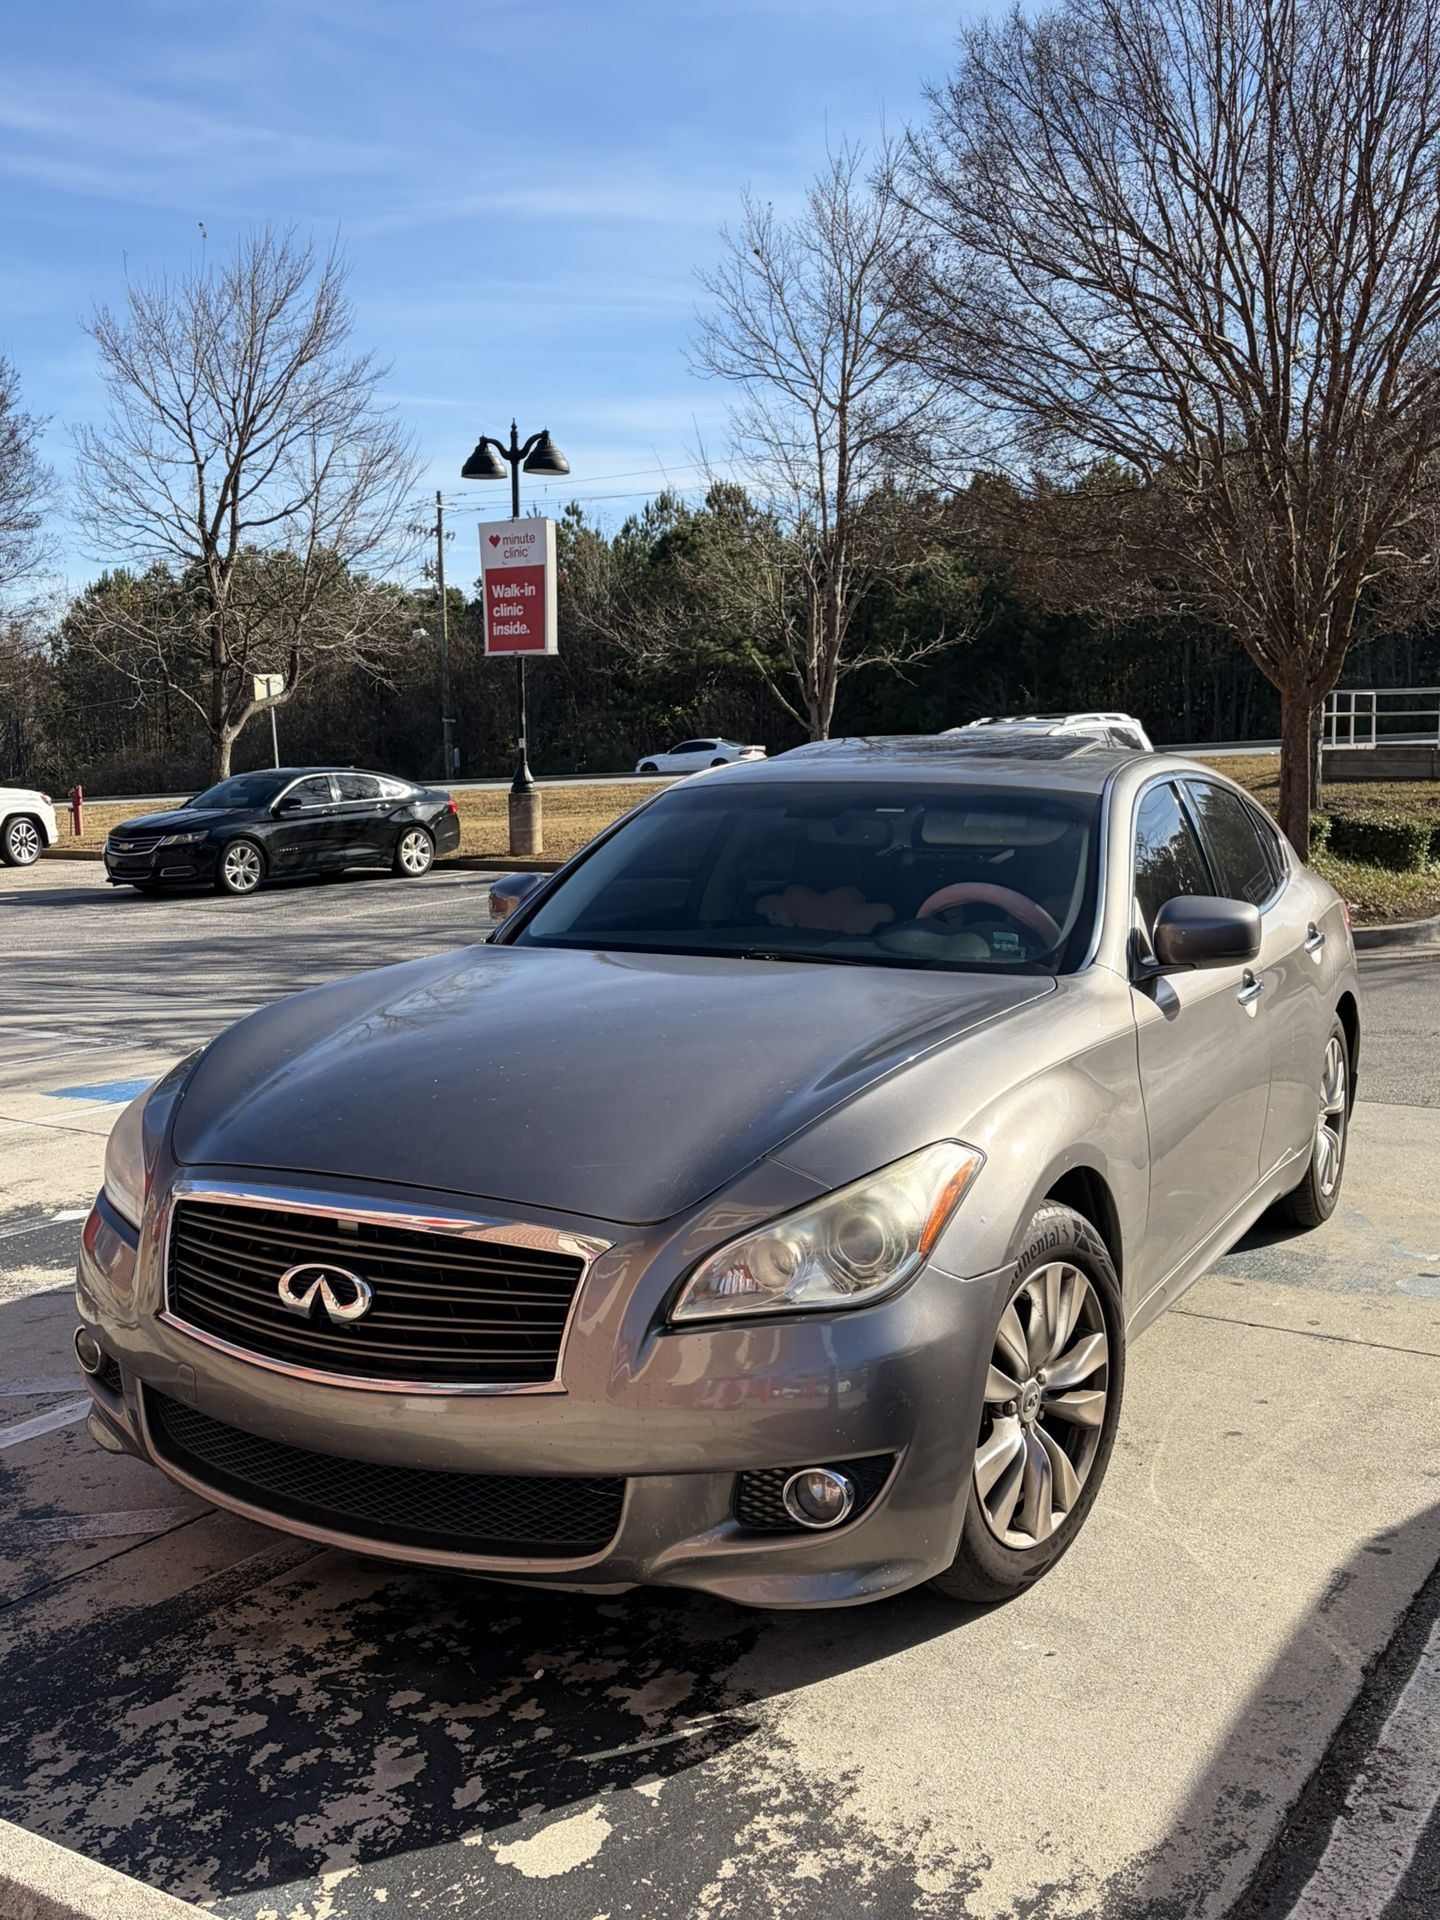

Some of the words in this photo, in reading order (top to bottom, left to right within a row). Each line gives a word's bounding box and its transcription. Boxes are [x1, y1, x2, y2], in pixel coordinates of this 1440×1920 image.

[502, 532, 536, 546] minute
[503, 546, 529, 559] clinic
[491, 582, 536, 598] Walk-in
[493, 602, 524, 617] clinic
[493, 621, 530, 636] inside.
[1009, 1224, 1060, 1288] inental
